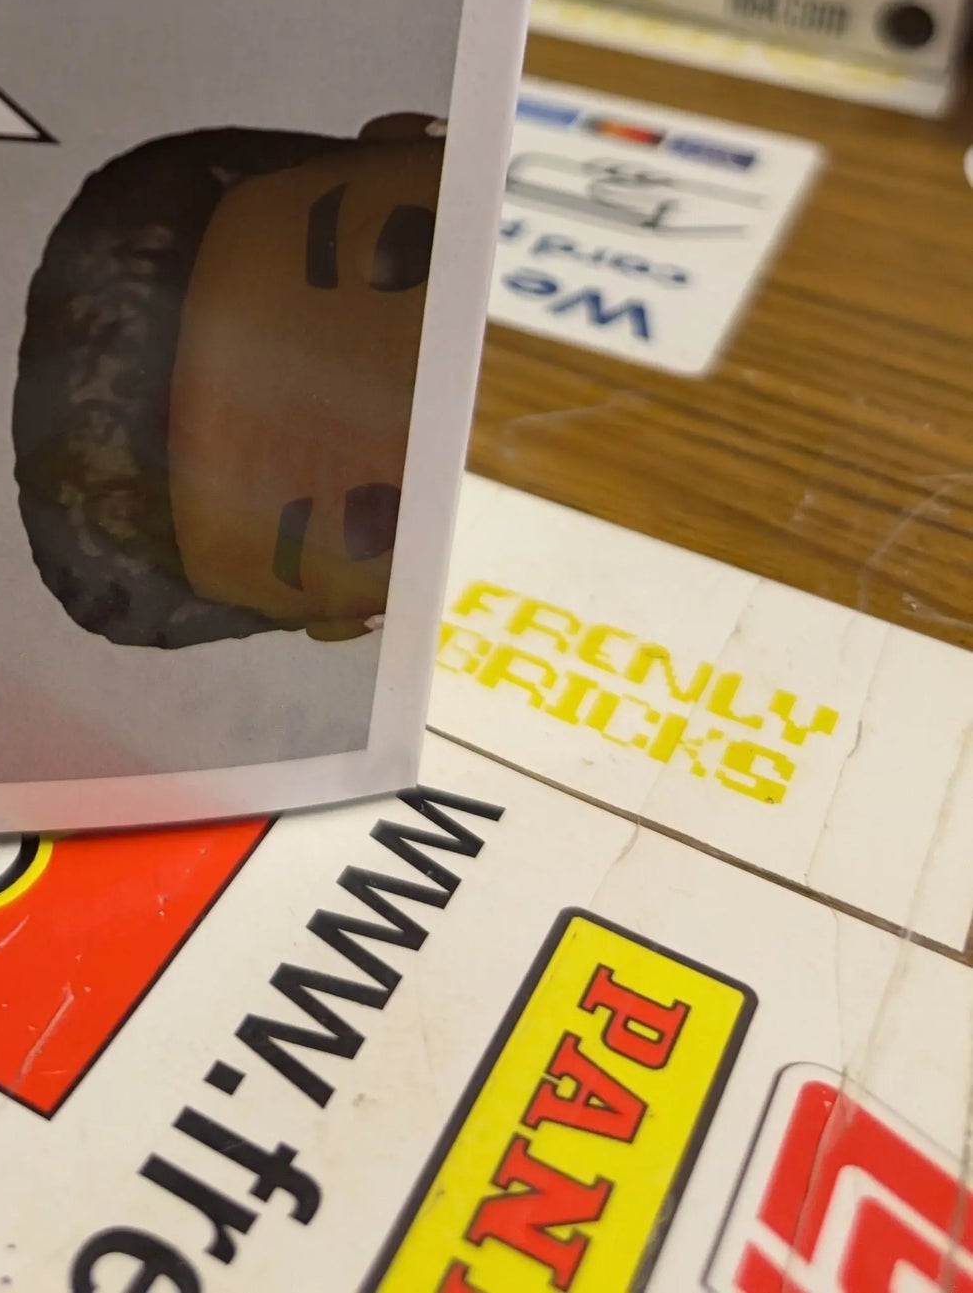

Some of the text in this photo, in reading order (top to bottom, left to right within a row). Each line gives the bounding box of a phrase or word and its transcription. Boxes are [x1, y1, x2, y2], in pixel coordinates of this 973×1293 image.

[501, 270, 651, 342] We
[530, 233, 689, 288] card
[436, 620, 797, 804] BRICKS
[451, 579, 839, 747] FRENLY
[435, 963, 691, 1293] PAN
